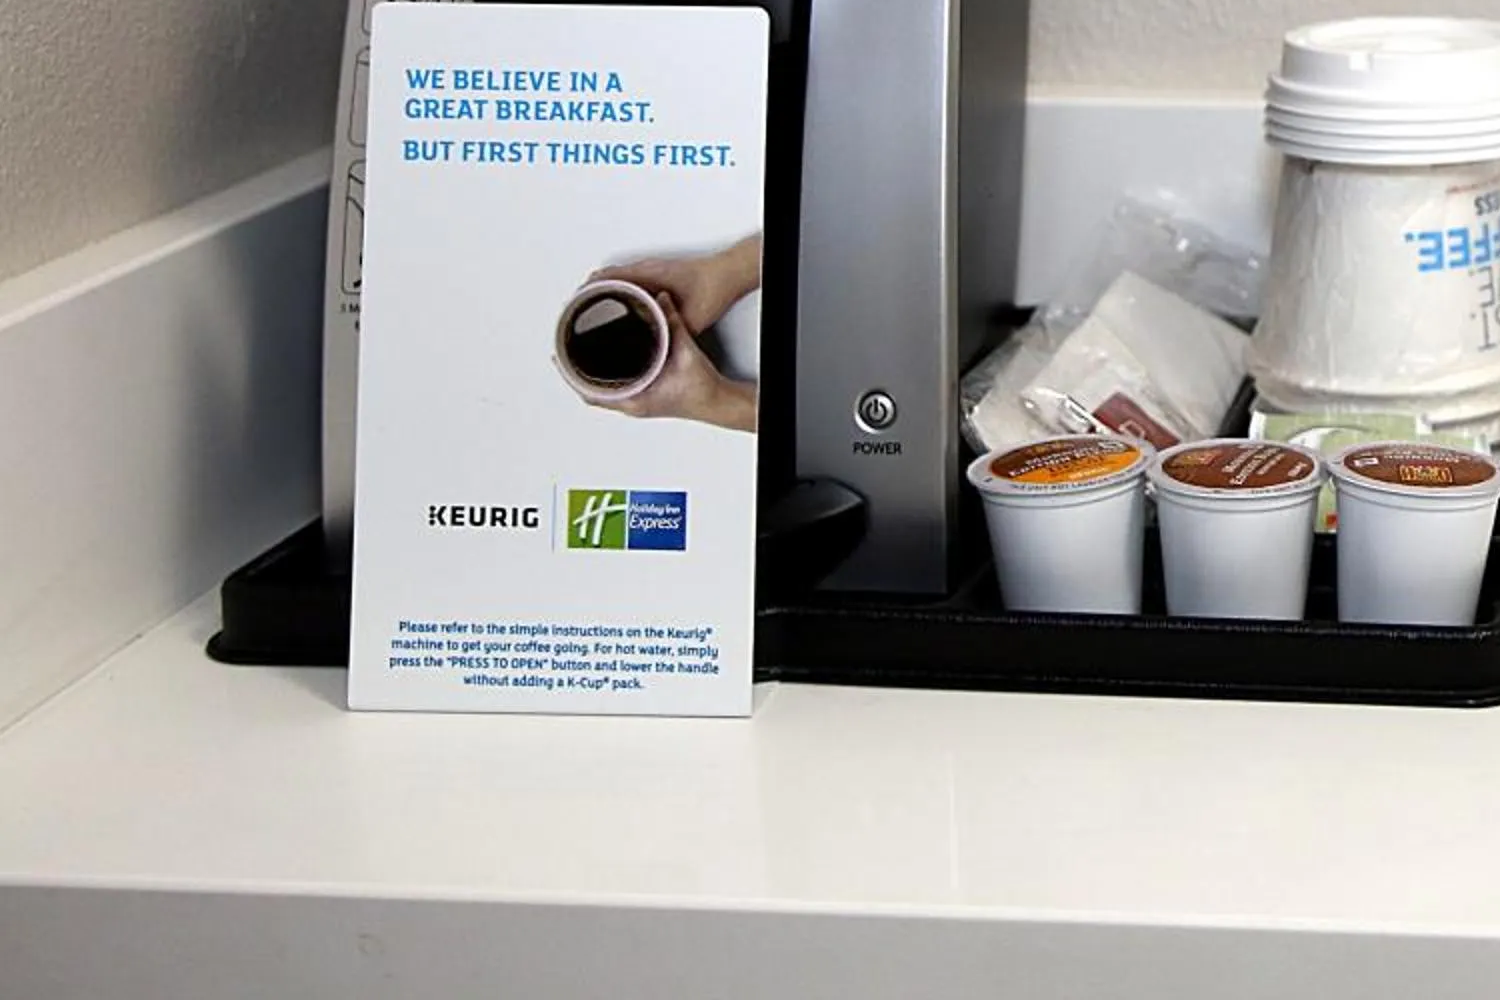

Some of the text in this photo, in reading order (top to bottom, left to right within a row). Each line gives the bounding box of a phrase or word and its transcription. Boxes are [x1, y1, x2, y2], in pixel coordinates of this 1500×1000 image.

[405, 68, 623, 93] WE BELIEVE IN A
[404, 98, 655, 123] GREAT BREAKFAST.
[402, 140, 736, 167] BUT FIRST THINGS FIRST.
[853, 442, 902, 454] POWER
[428, 505, 540, 528] KEURIG
[629, 503, 681, 516] Holiday Inn
[399, 621, 438, 633] Please
[441, 622, 468, 633] refer
[471, 623, 484, 634] to
[487, 623, 506, 634] the
[509, 624, 549, 637] simple
[551, 624, 623, 637] instructions
[626, 628, 642, 637] on
[645, 627, 664, 638] the
[391, 638, 443, 650] machine
[447, 639, 459, 650] to
[462, 640, 481, 652] get
[484, 642, 511, 654] your
[514, 641, 550, 652] coffee
[594, 643, 613, 654] For
[615, 644, 635, 655] hot
[638, 645, 674, 657] water,
[677, 645, 718, 659] simply
[389, 656, 720, 674] press the "PRESS TO OPEN" button and lower the handle
[464, 674, 509, 686] without
[512, 675, 554, 690] adding
[557, 679, 564, 688] a
[612, 677, 646, 690] pack.
